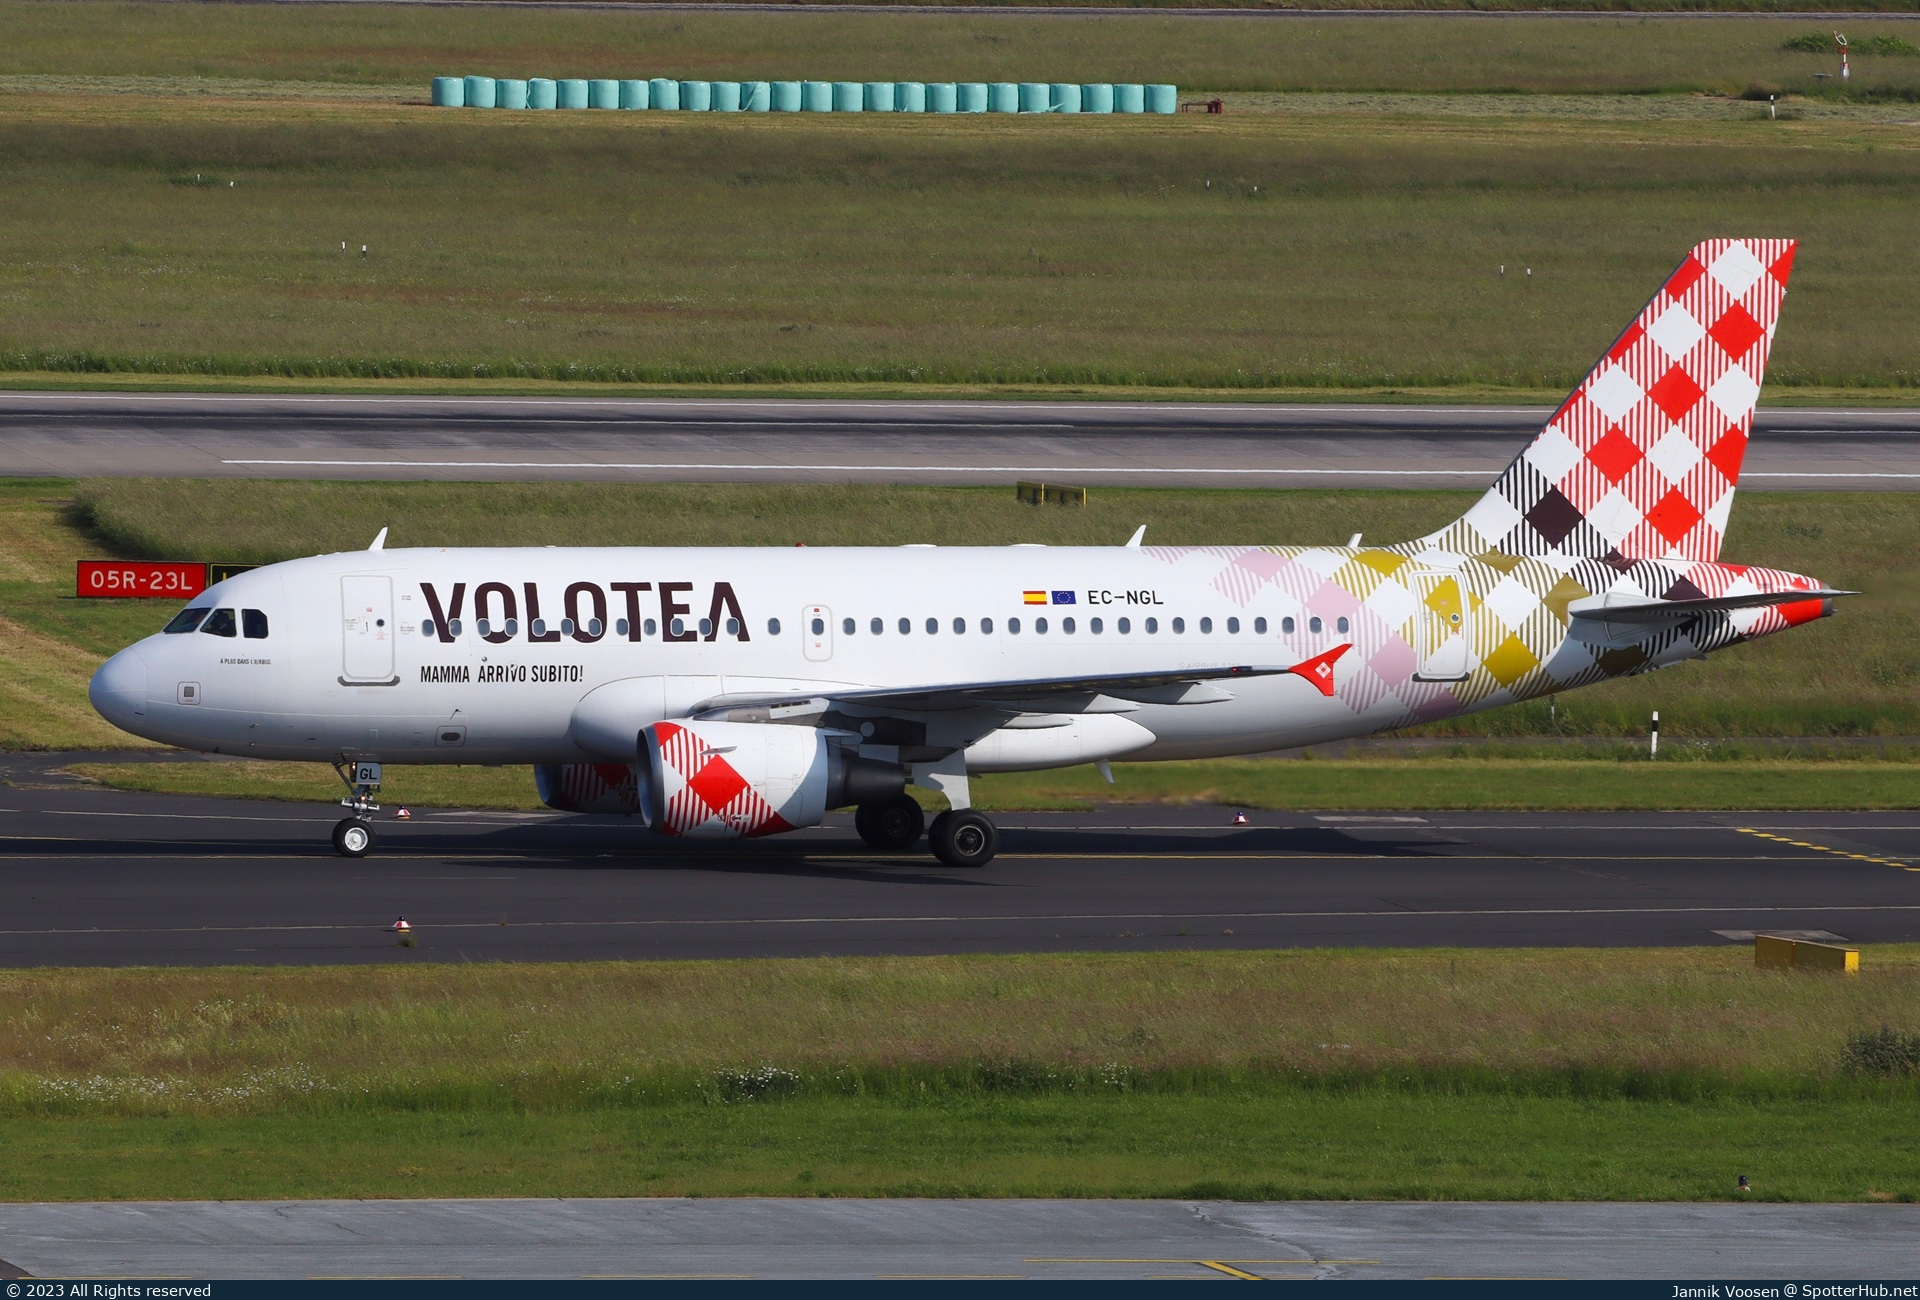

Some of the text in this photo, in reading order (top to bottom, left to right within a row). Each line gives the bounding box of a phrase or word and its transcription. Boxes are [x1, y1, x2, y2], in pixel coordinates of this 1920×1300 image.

[90, 570, 193, 590] 05R-23L
[1087, 590, 1164, 605] EC-NGL
[419, 581, 751, 643] VOLOTEA
[420, 665, 583, 683] MAMMA ARRIVO SUBITO!
[360, 768, 378, 780] GL
